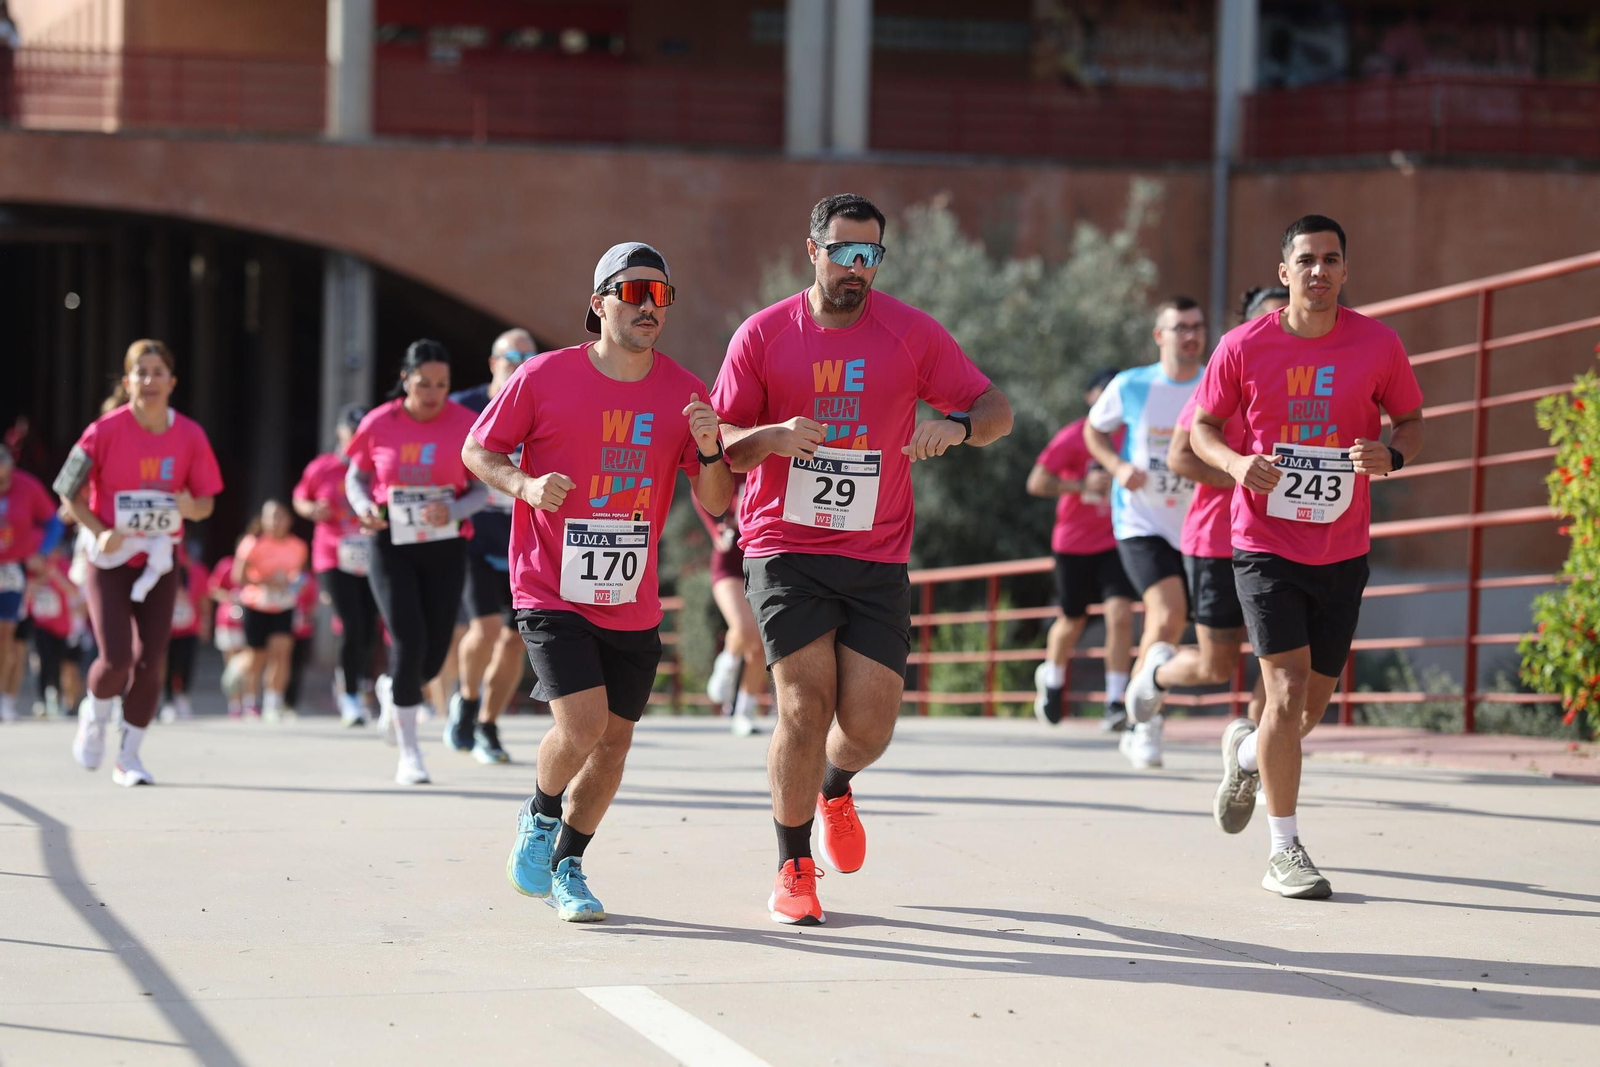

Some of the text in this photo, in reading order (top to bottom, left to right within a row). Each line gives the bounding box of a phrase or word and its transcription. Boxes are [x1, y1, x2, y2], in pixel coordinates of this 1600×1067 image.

[812, 358, 865, 393] WE
[1286, 365, 1335, 396] WE
[816, 398, 858, 419] RUN
[1290, 400, 1329, 421] RUN
[602, 409, 654, 446] WE
[822, 425, 868, 450] MA
[401, 443, 436, 464] WE
[602, 448, 645, 472] RUN
[797, 458, 835, 472] UMA
[1278, 456, 1314, 469] UMA
[140, 456, 175, 480] WE
[588, 475, 652, 510] UMA
[812, 476, 856, 507] 29
[1284, 472, 1342, 502] 243
[128, 512, 170, 531] 426
[816, 515, 831, 524] WE
[1297, 510, 1312, 518] WE
[570, 532, 610, 546] UMA
[580, 550, 638, 581] 170
